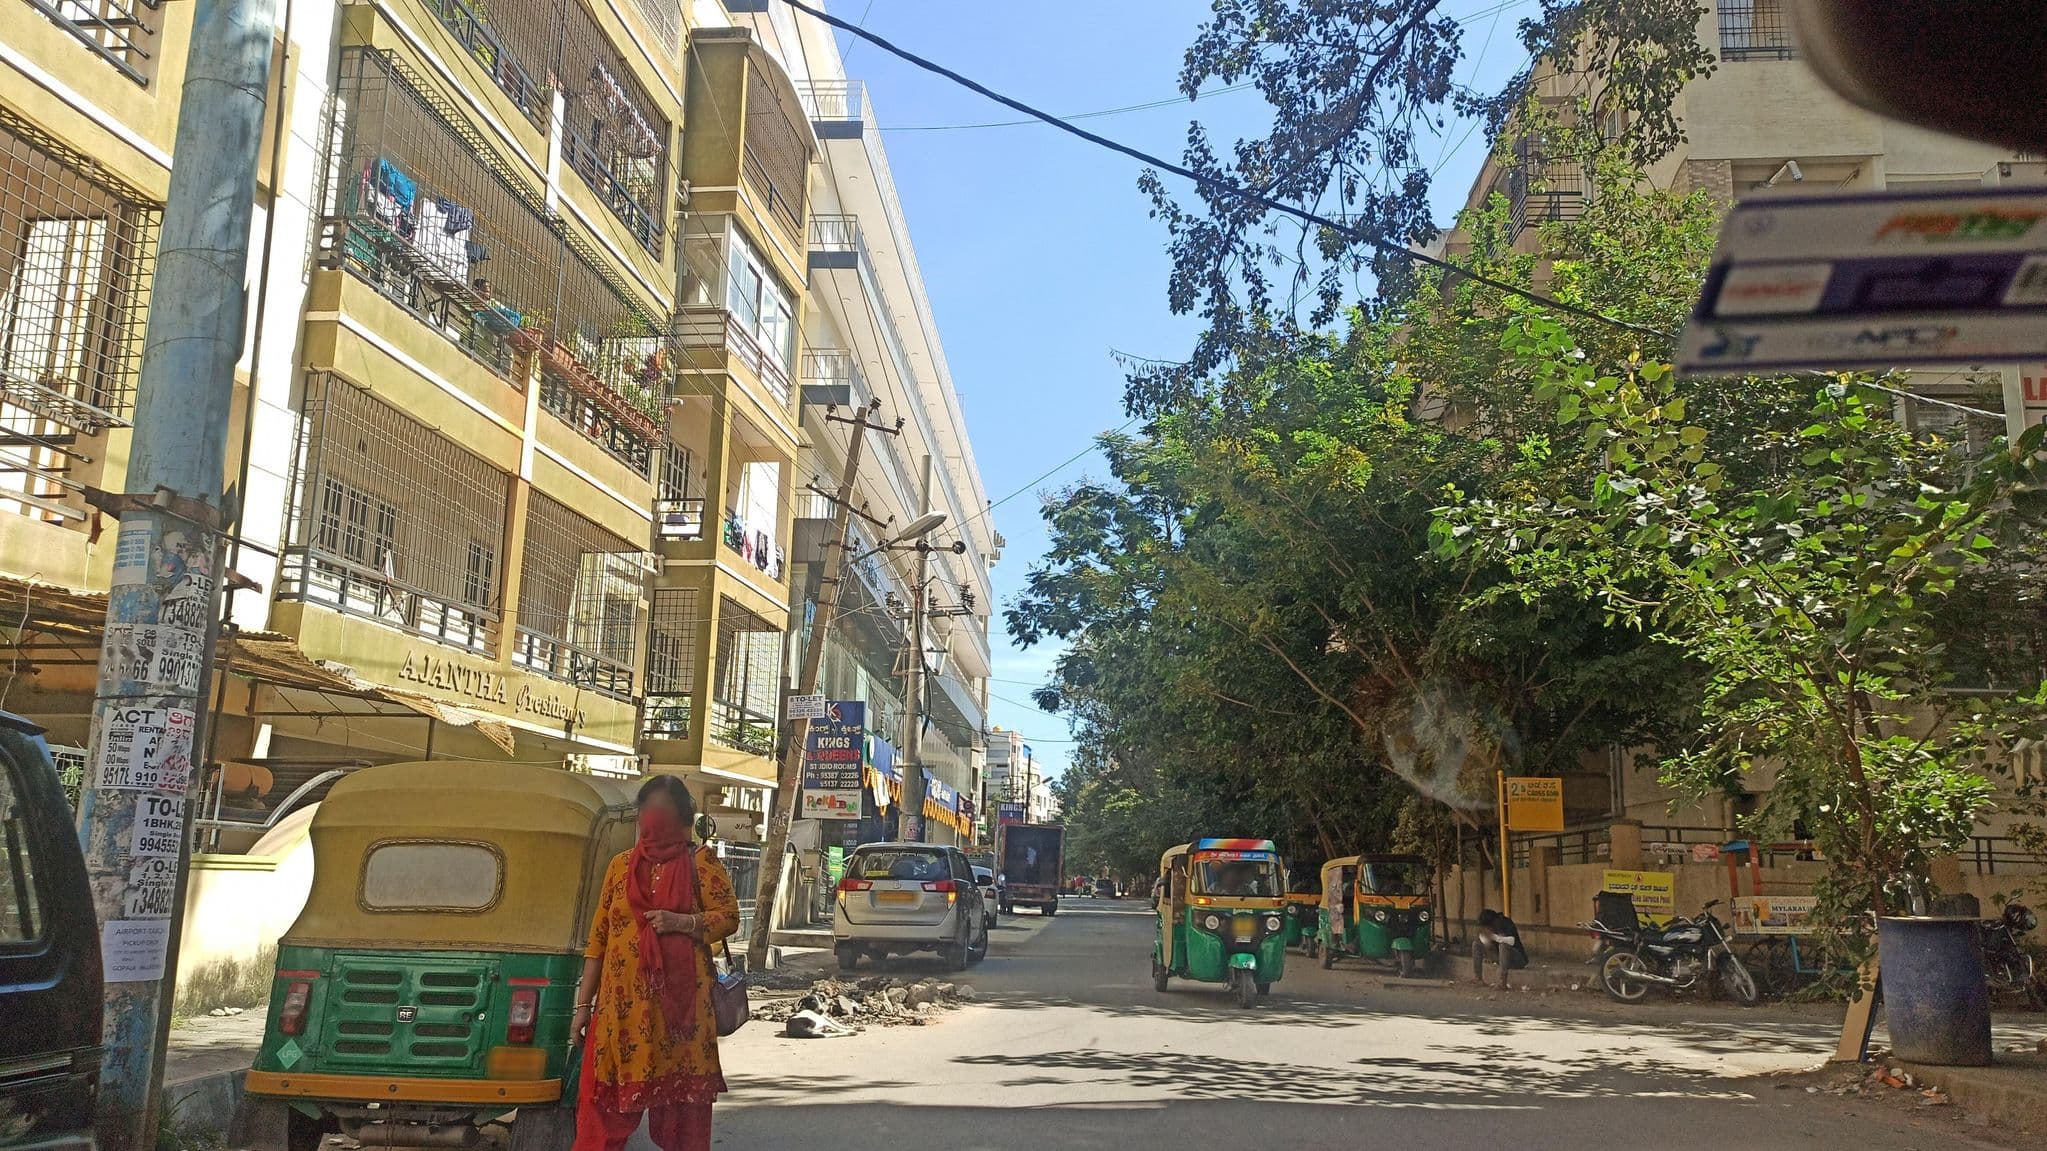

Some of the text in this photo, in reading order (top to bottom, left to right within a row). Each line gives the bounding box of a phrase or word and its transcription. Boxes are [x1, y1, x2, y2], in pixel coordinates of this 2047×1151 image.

[399, 649, 507, 704] AJANTHA
[112, 708, 156, 725] ACT
[817, 737, 850, 749] KINGS
[1000, 803, 1023, 811] KINGS
